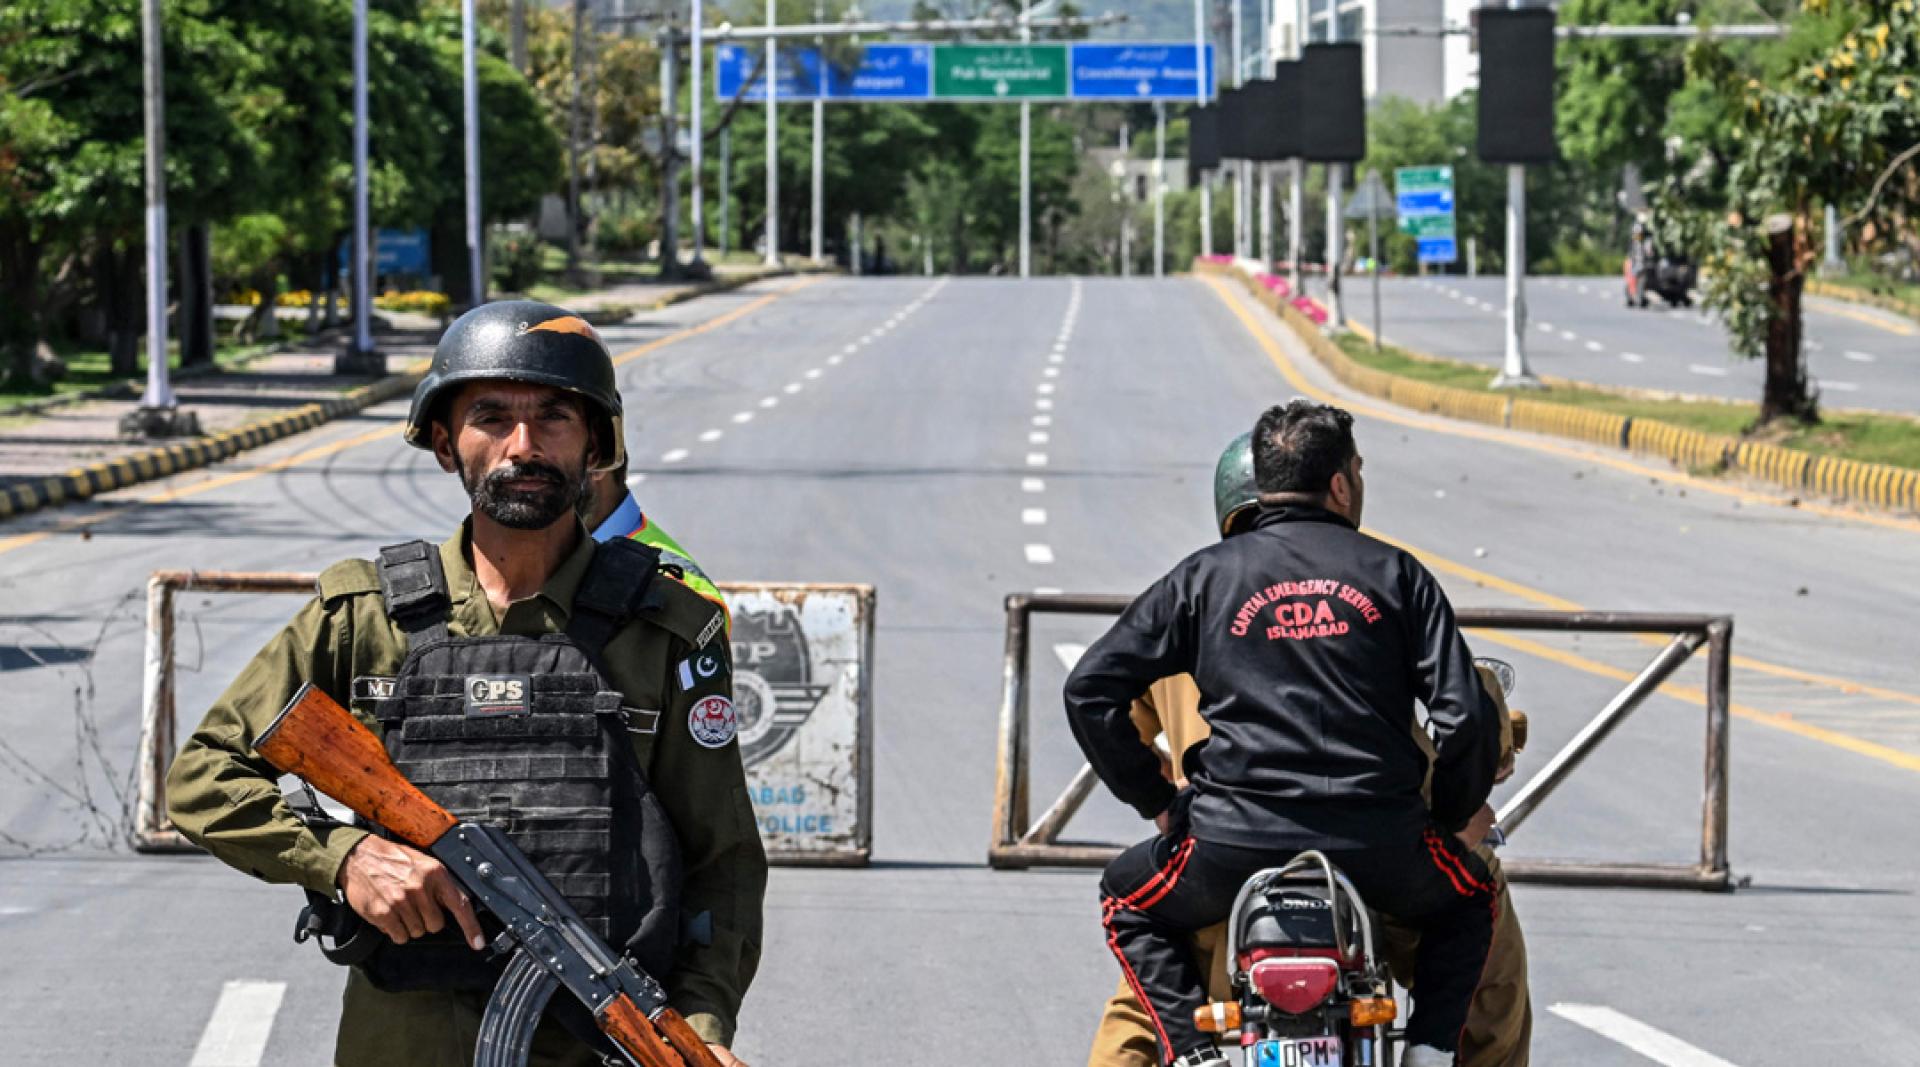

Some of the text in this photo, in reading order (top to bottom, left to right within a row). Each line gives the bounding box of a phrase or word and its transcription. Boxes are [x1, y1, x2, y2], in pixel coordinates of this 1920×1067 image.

[1230, 579, 1382, 636] CAPITAL EMERGENCY SERVICE
[1275, 599, 1335, 626] CDA
[1266, 621, 1349, 640] ISLAMABAD
[471, 679, 523, 700] GPS
[757, 814, 832, 833] OLICE
